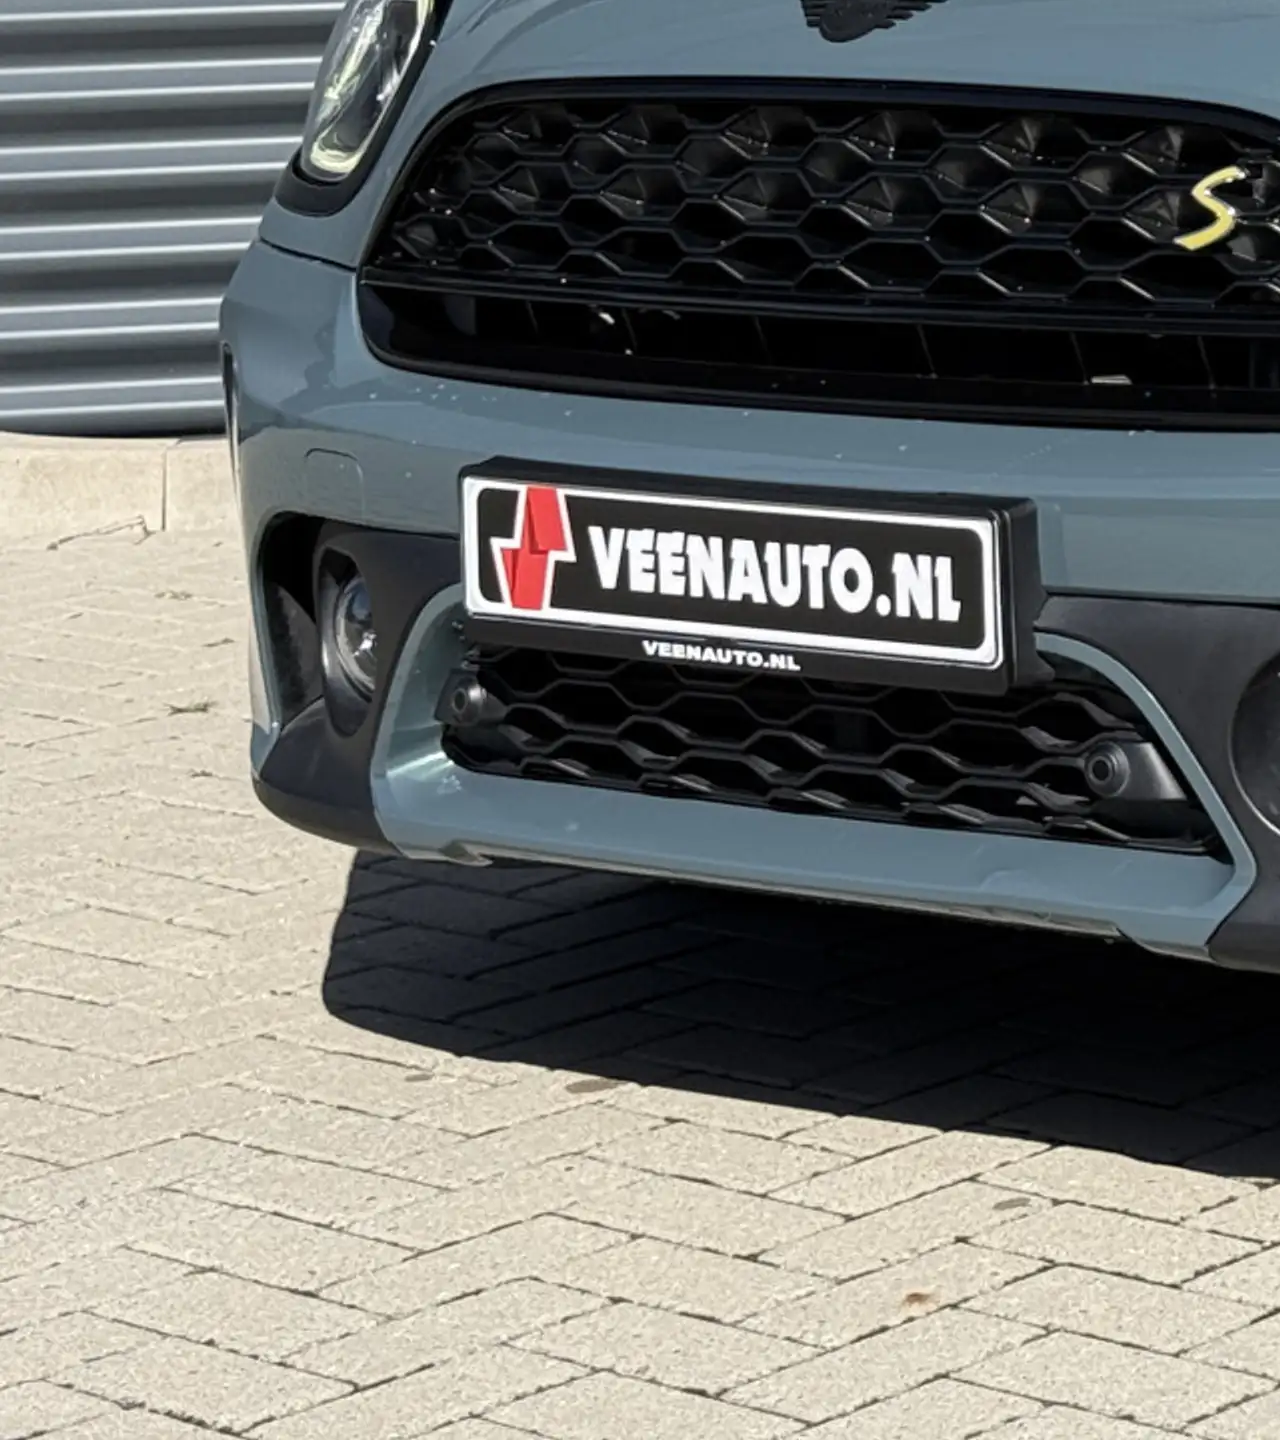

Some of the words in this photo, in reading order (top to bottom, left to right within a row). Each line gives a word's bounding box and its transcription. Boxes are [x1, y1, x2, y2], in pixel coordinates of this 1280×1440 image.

[1173, 165, 1247, 251] S
[587, 524, 962, 622] VEENAUTO.NL
[641, 639, 801, 671] VEENAUTO.NL
